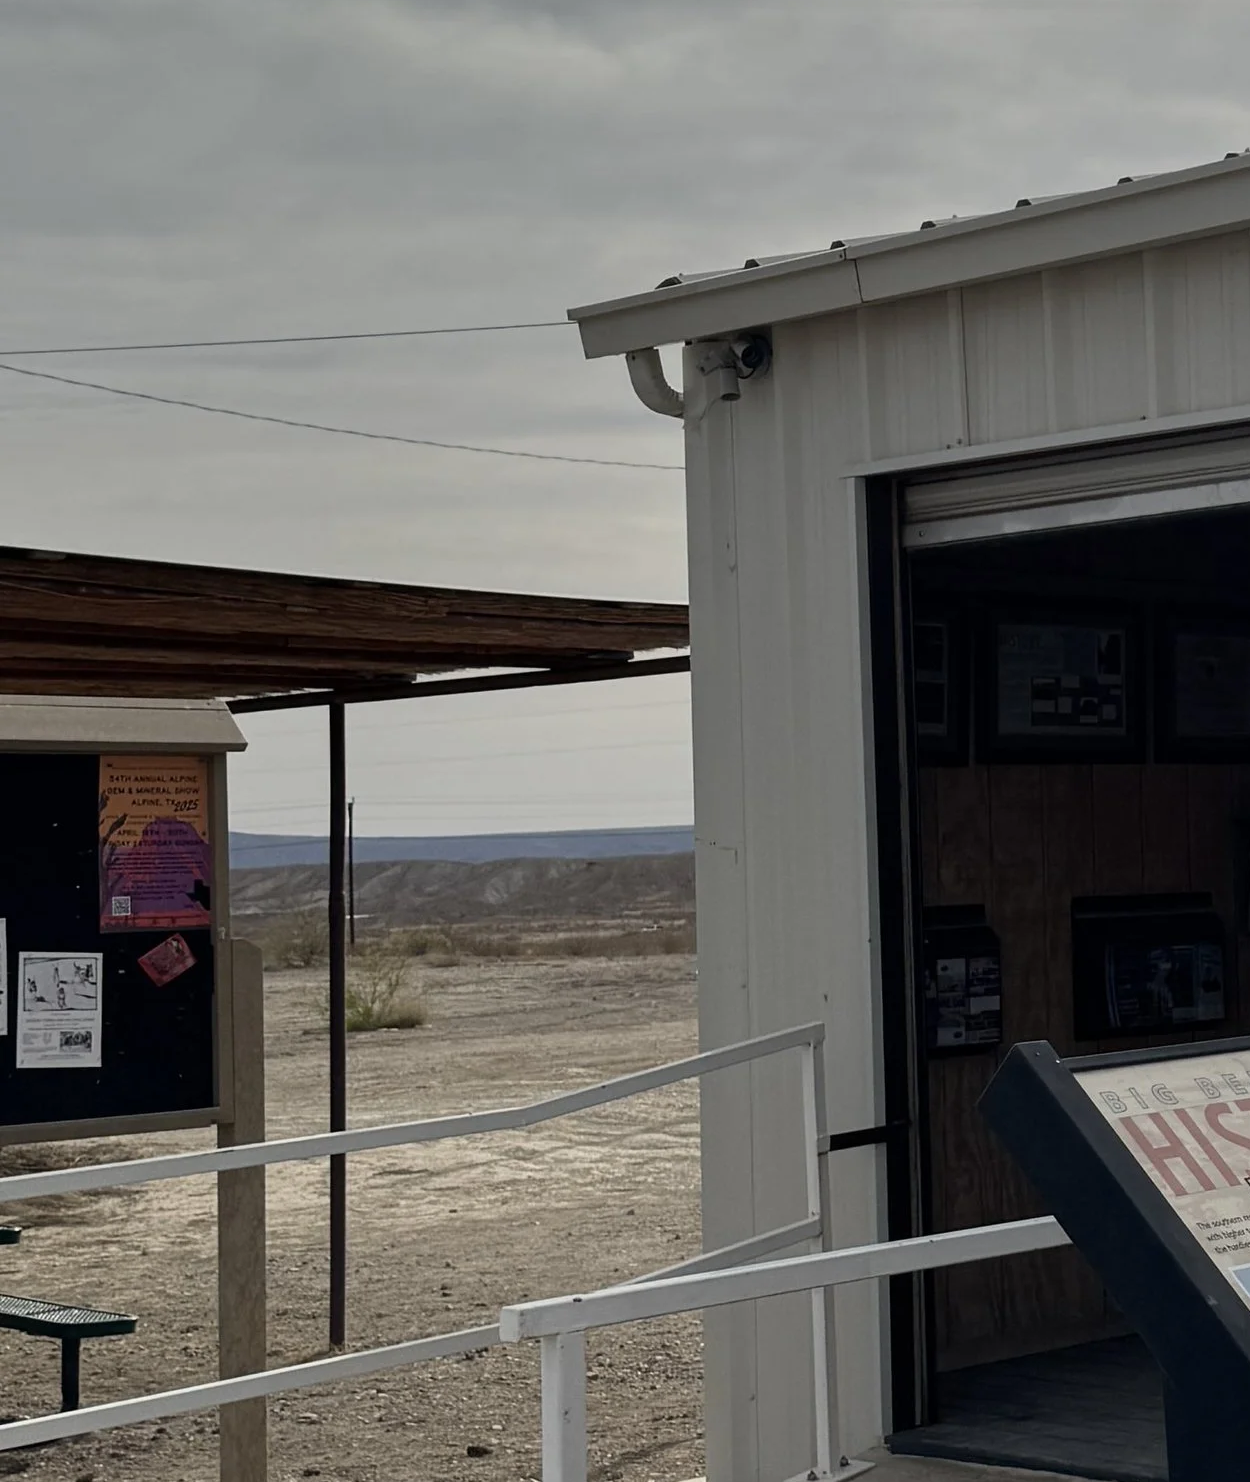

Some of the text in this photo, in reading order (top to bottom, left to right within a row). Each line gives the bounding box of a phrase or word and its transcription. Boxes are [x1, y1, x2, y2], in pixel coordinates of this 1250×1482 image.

[169, 775, 198, 783] ALPINE
[135, 787, 171, 795] MINERAL
[174, 787, 200, 795] SHOW
[174, 799, 199, 812] 2025
[1100, 1084, 1179, 1113] BIG
